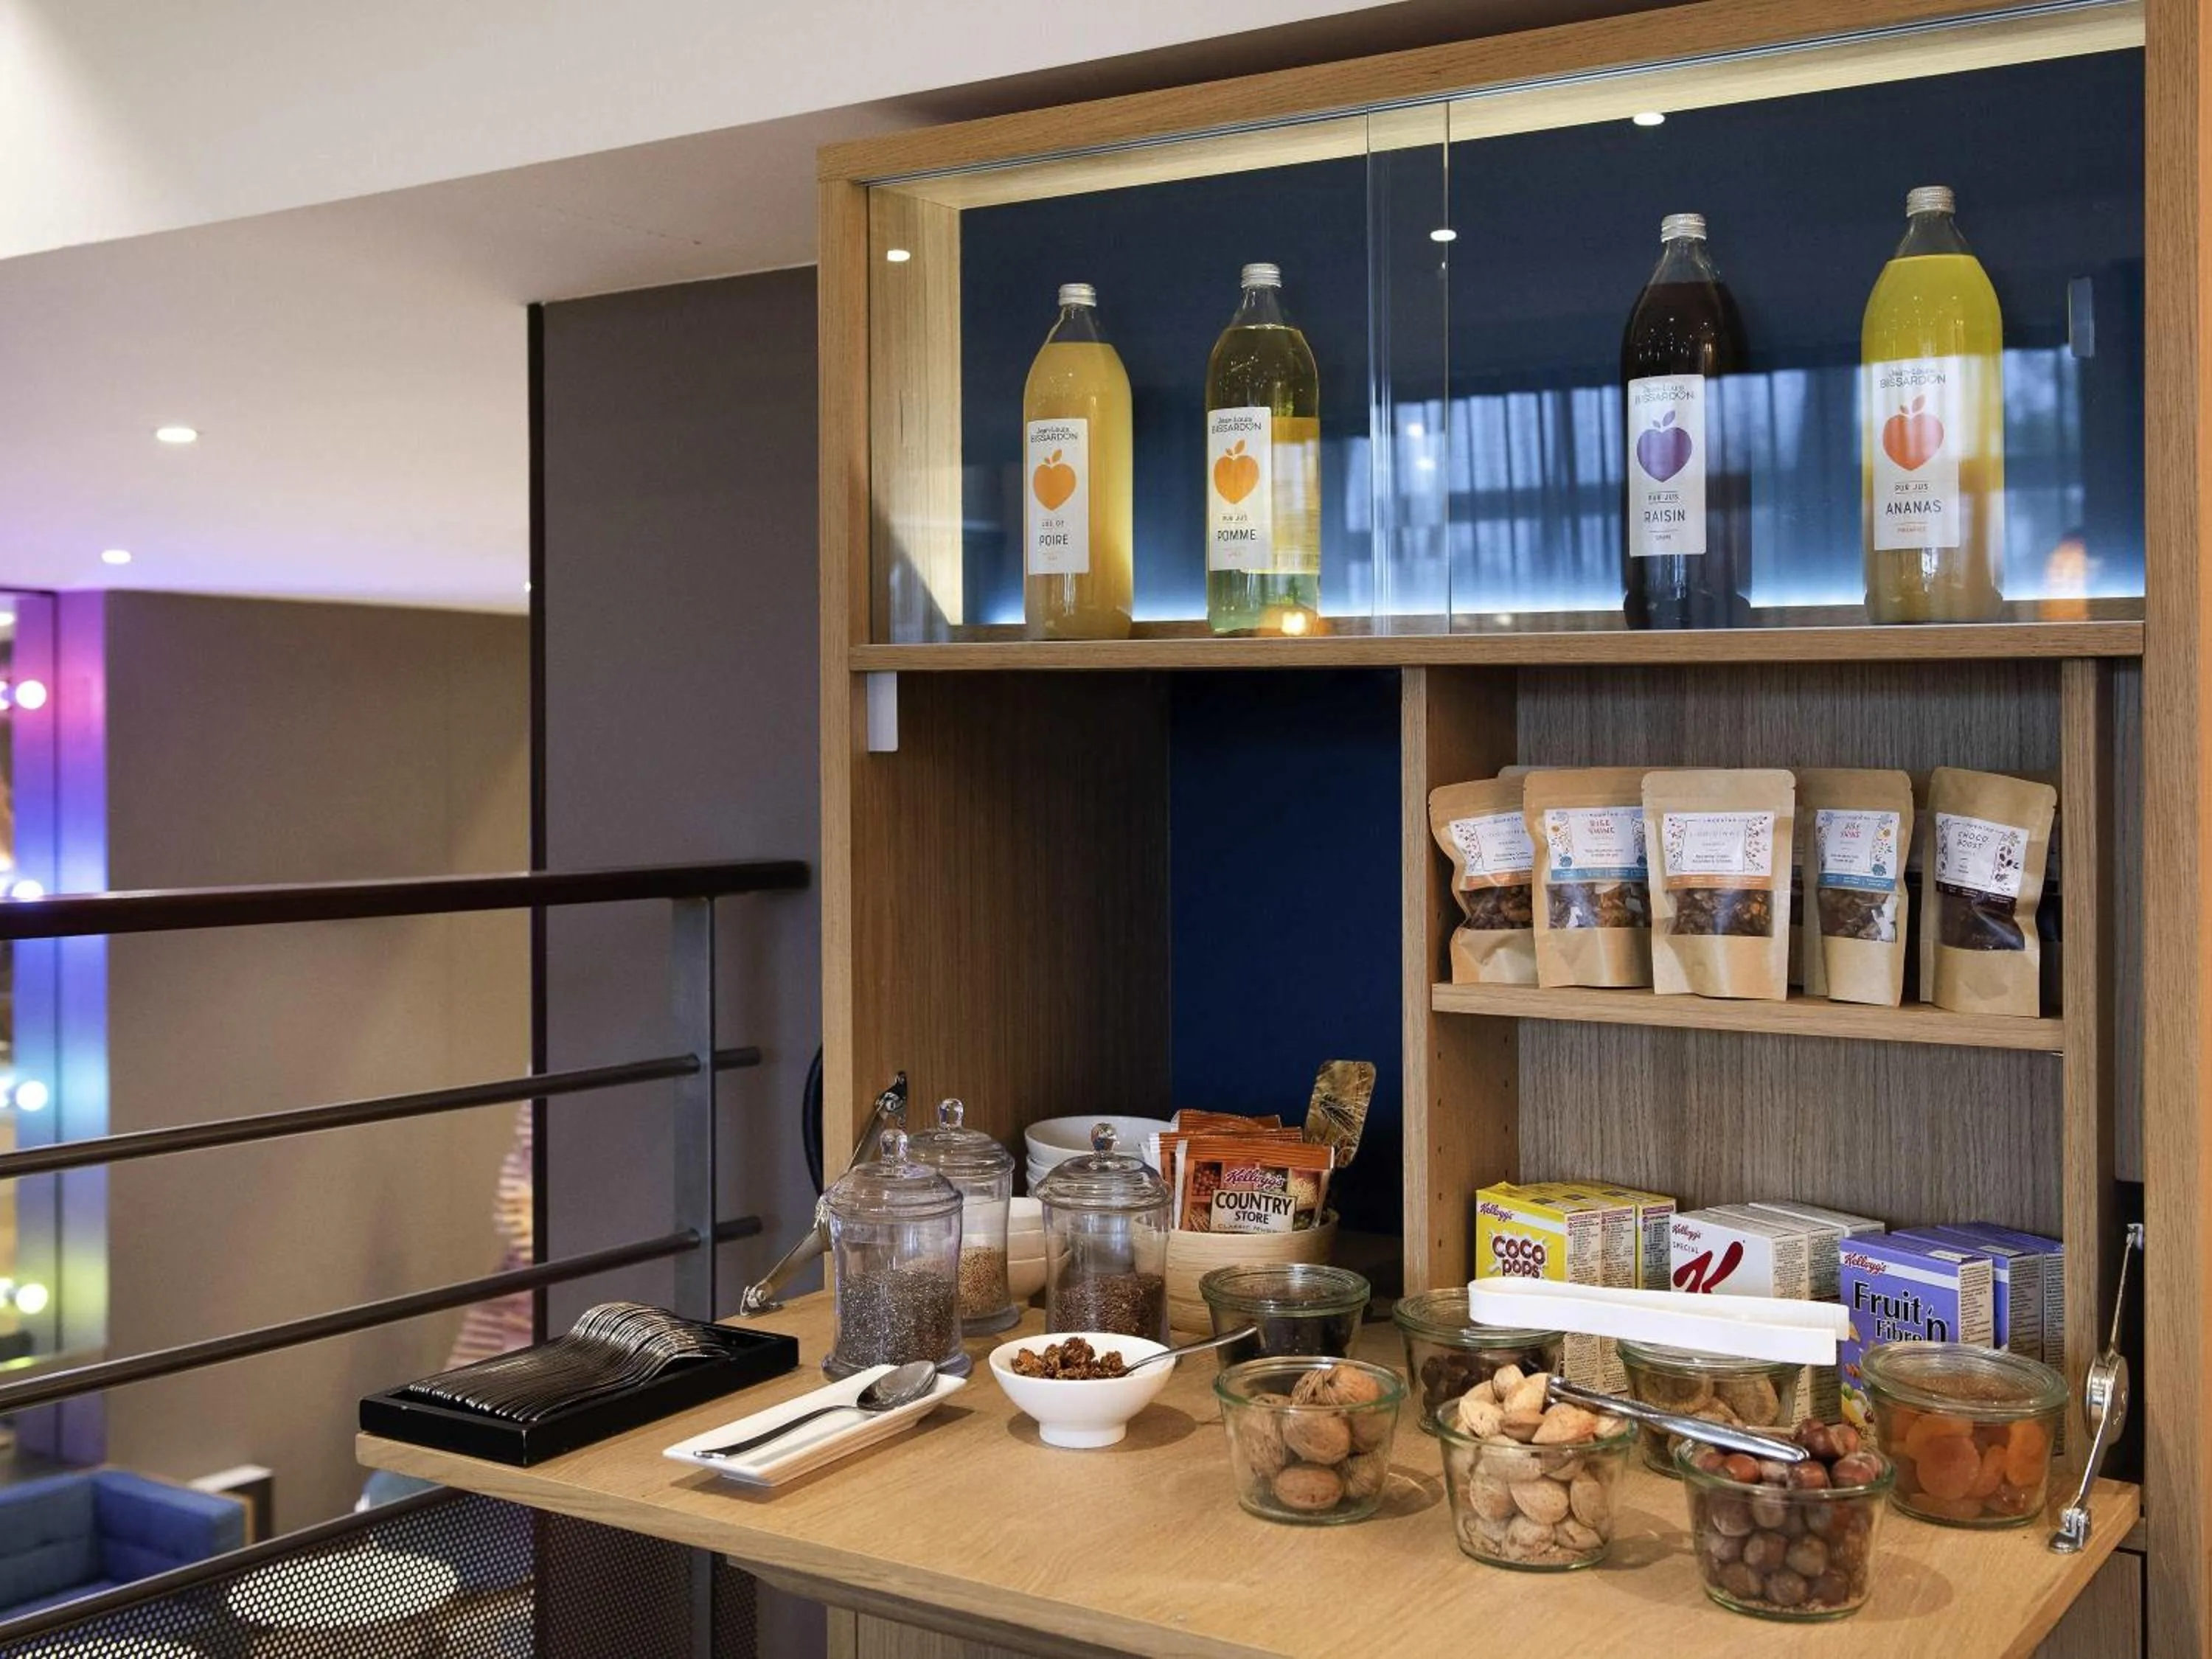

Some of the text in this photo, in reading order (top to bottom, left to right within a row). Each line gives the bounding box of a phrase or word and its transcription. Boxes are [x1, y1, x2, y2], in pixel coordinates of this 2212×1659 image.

[1644, 509, 1686, 523] RAISIN
[1886, 499, 1941, 515] ANANAS
[1039, 534, 1068, 546] POIRE
[1217, 529, 1256, 541] POMME
[1225, 1168, 1284, 1191] Kellogg's
[1215, 1192, 1292, 1215] COUNTRY
[1481, 1203, 1512, 1222] Kellogg's
[1234, 1211, 1269, 1225] STORE
[1673, 1241, 1743, 1293] K
[1844, 1252, 1887, 1275] Kellogg's
[1854, 1280, 1923, 1326] Fruit
[1876, 1318, 1923, 1342] Fibre
